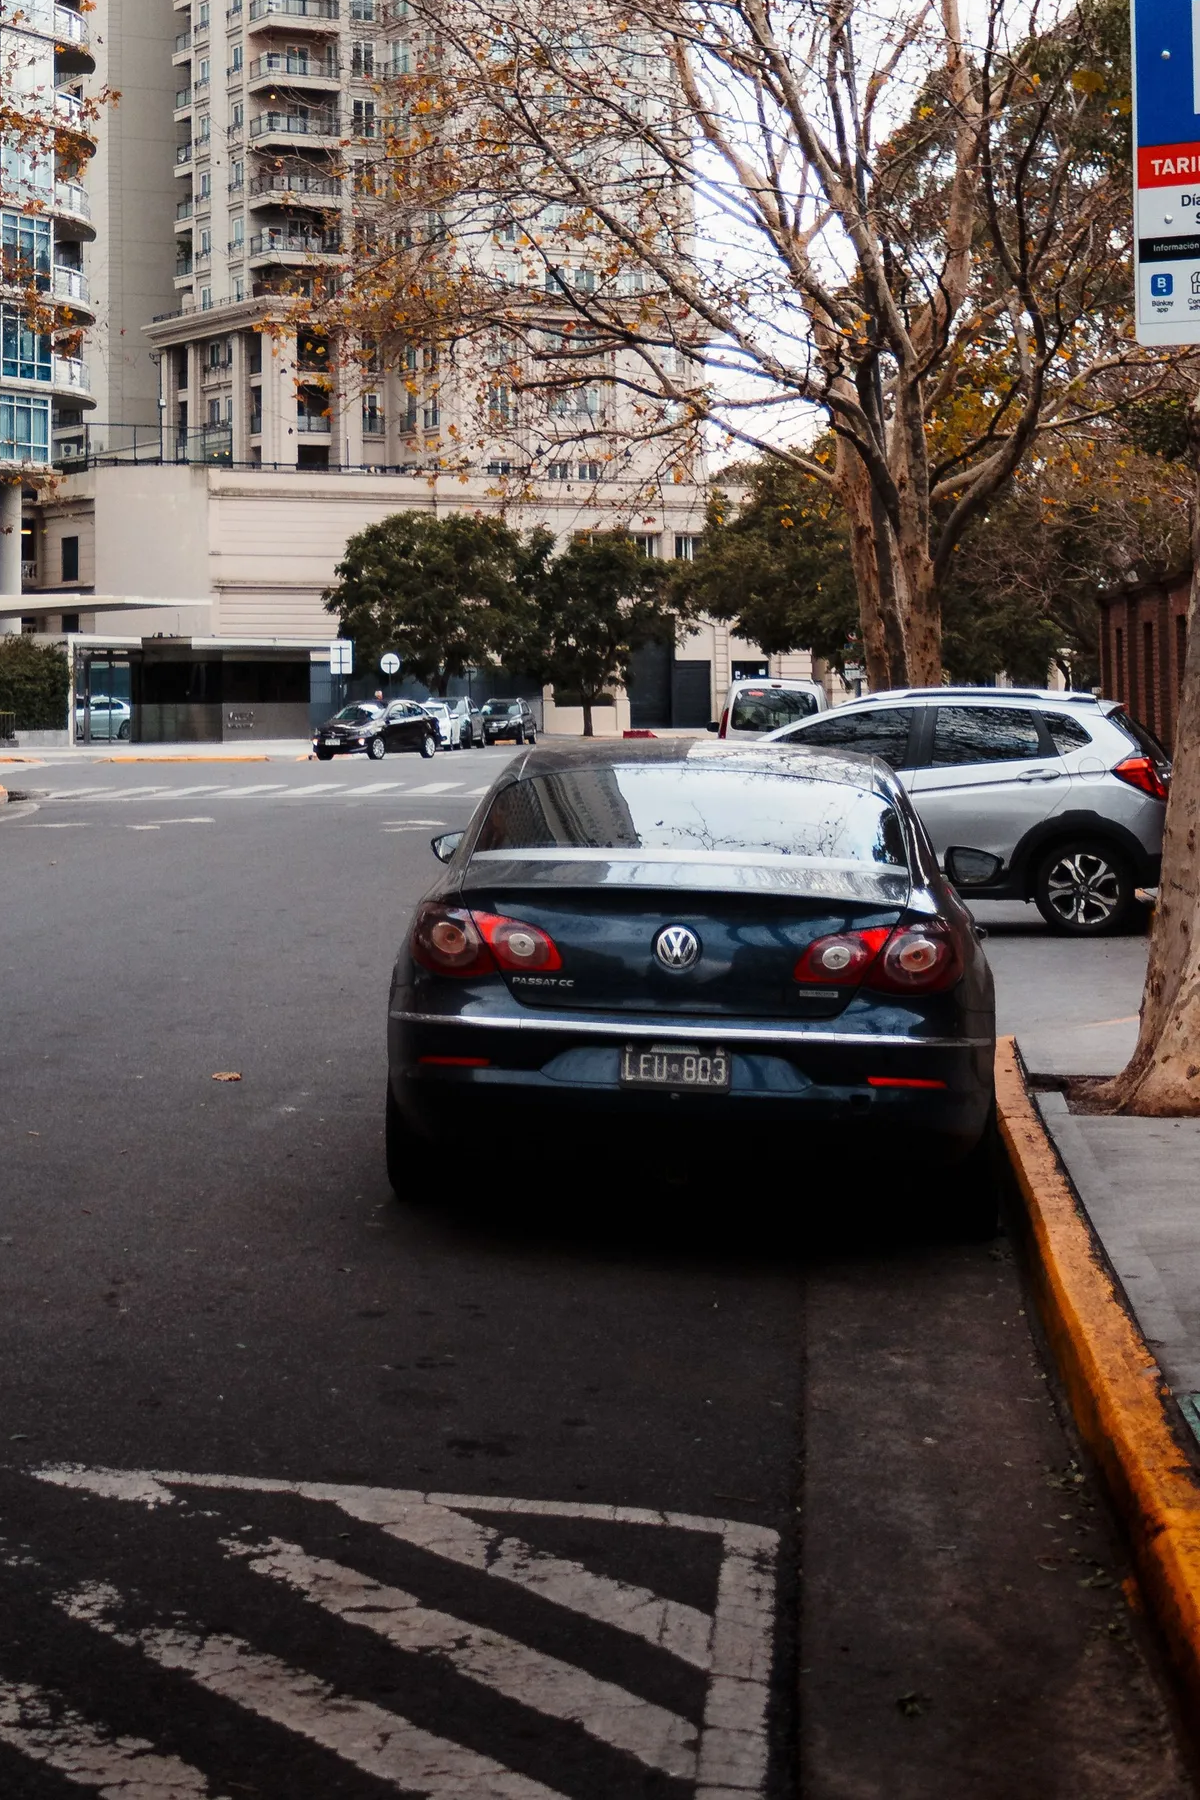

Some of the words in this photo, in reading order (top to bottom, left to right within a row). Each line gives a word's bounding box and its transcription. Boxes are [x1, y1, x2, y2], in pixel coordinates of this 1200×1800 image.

[1151, 156, 1200, 176] TARI
[1153, 242, 1200, 252] Información
[512, 976, 557, 986] PASSAT
[558, 979, 574, 987] CC
[683, 1056, 727, 1085] 803
